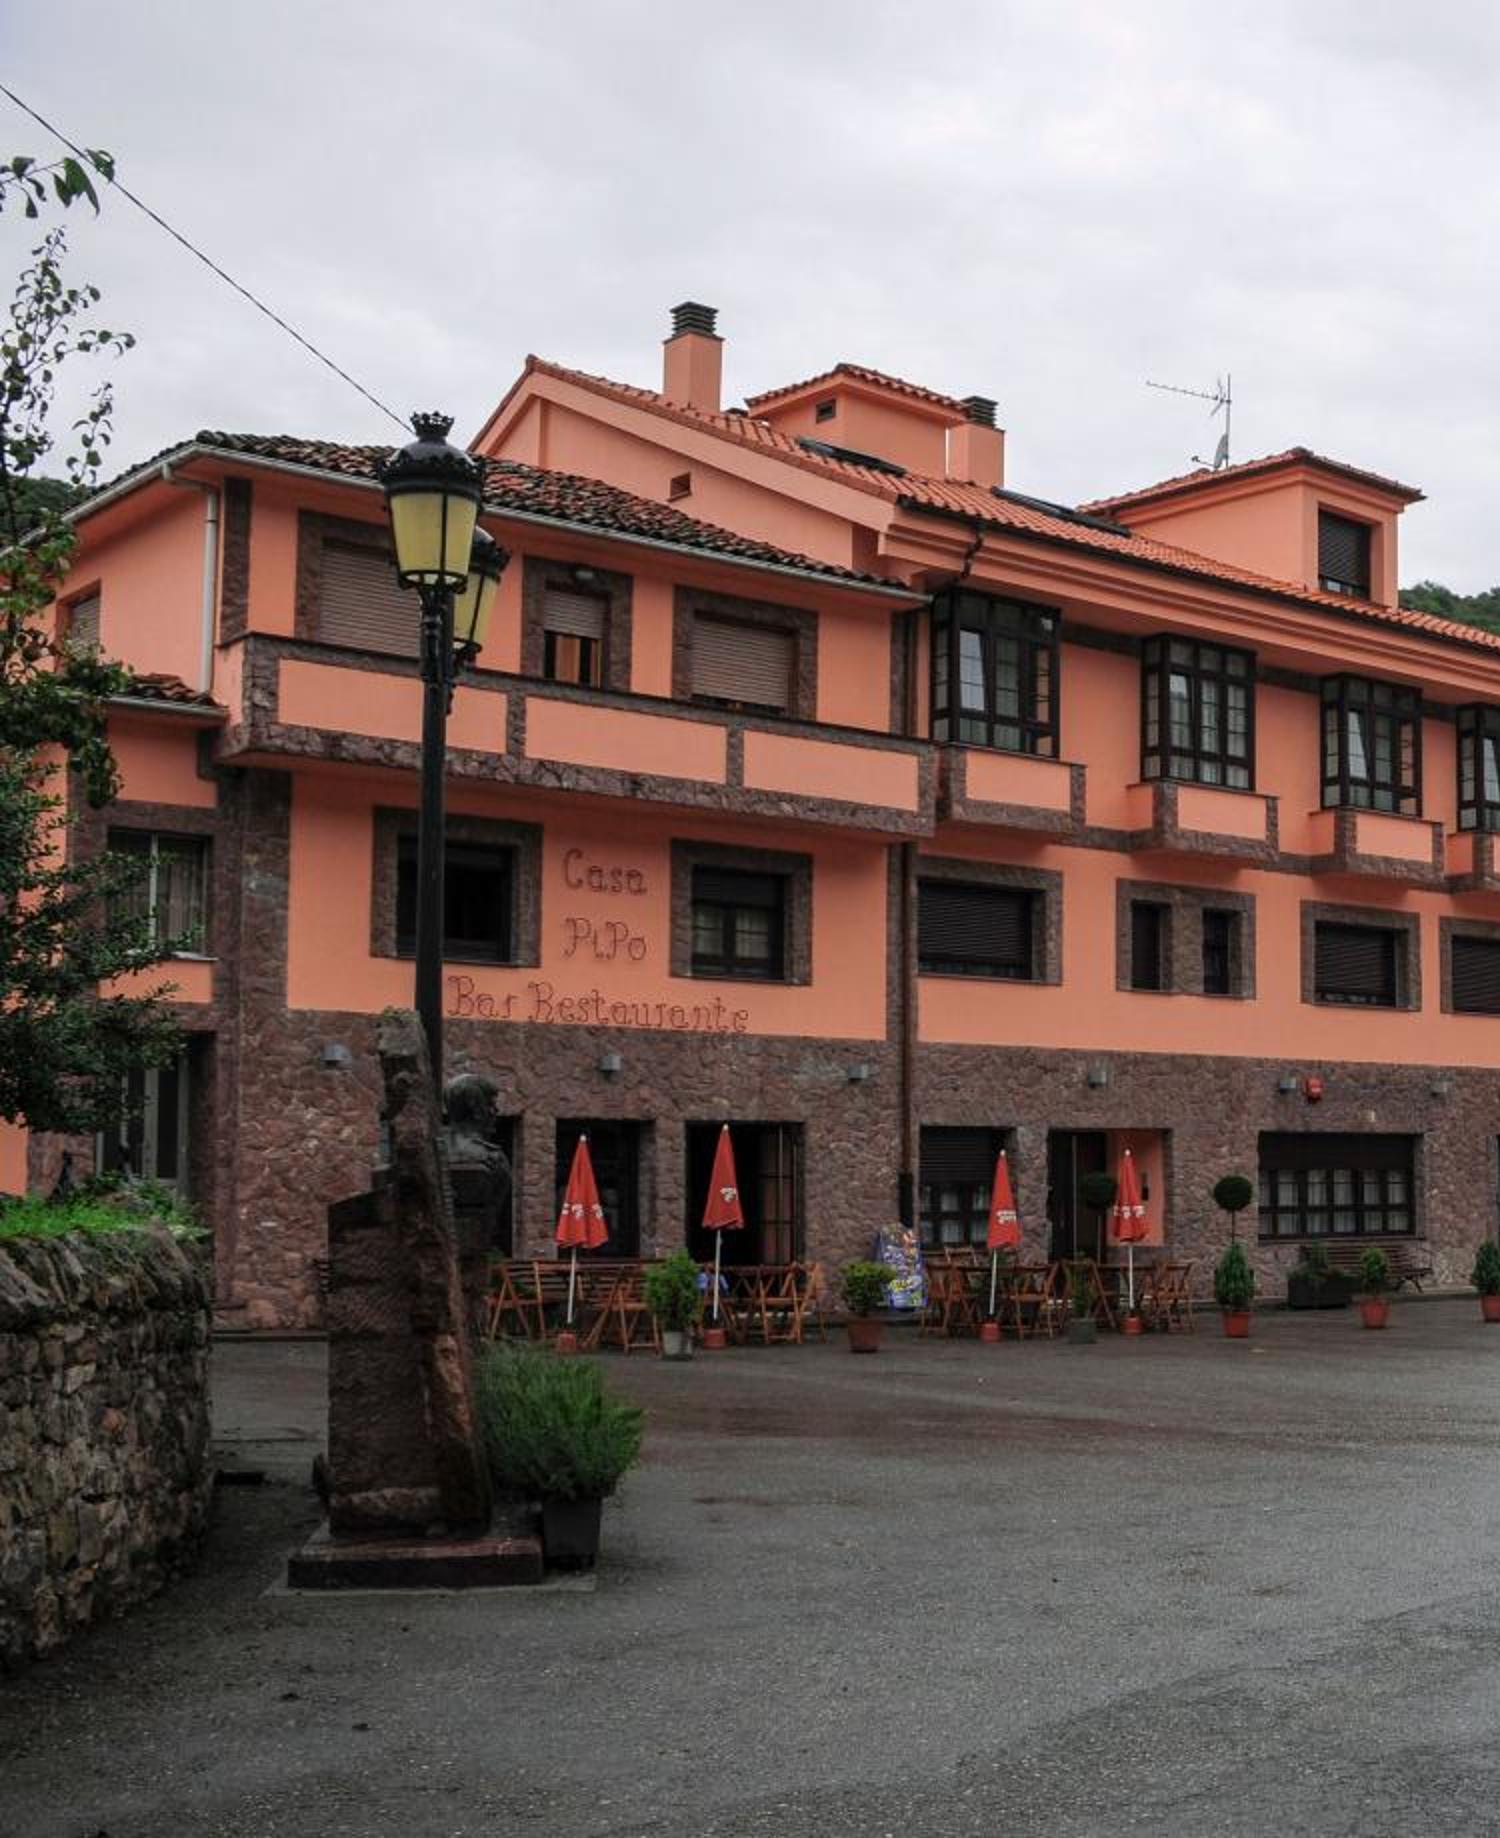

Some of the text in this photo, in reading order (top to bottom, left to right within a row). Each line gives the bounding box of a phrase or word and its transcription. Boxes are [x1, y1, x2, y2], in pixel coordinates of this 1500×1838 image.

[562, 847, 648, 897] Casa
[447, 975, 749, 1033] Bar Restaurante
